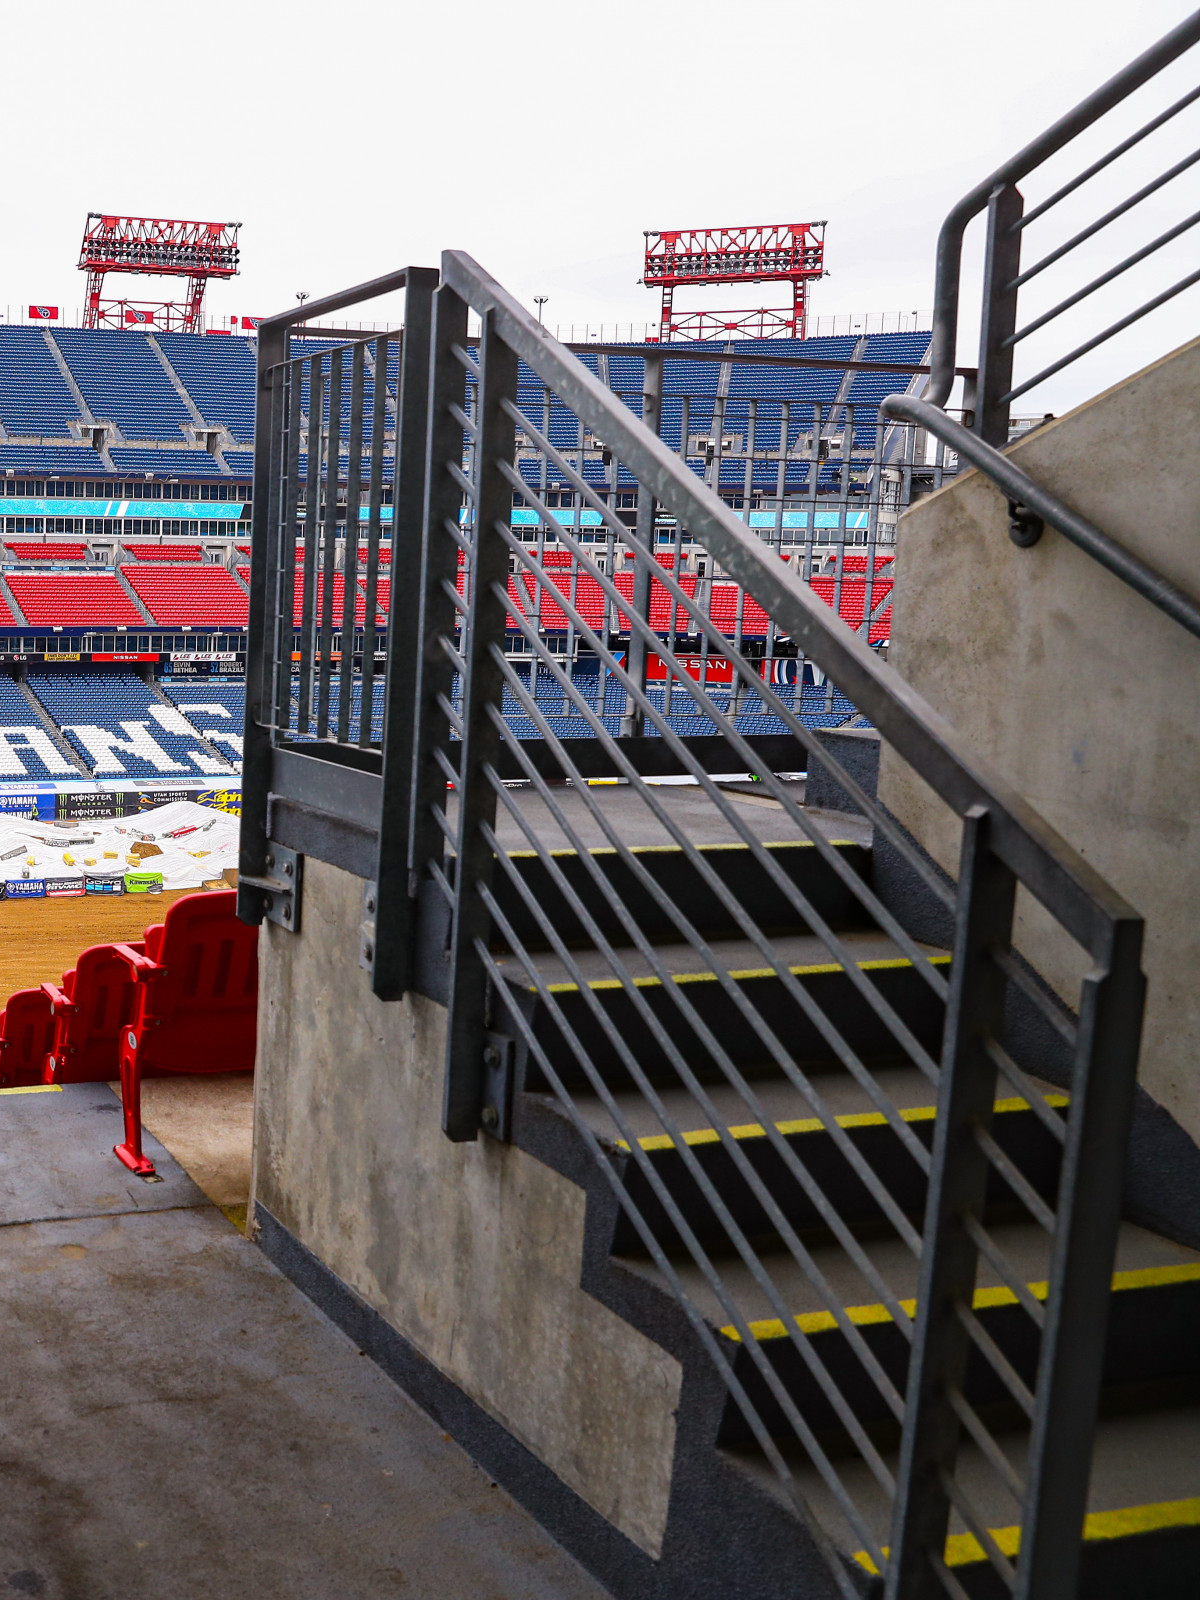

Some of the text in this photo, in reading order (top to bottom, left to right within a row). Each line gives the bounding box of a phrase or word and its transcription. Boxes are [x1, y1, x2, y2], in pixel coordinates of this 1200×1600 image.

[163, 663, 173, 673] 65
[210, 663, 219, 673] 52
[7, 796, 38, 805] YAMAHA
[70, 793, 112, 802] MONSTER
[70, 808, 112, 817] MONSTER
[15, 882, 44, 890] YAMAHA
